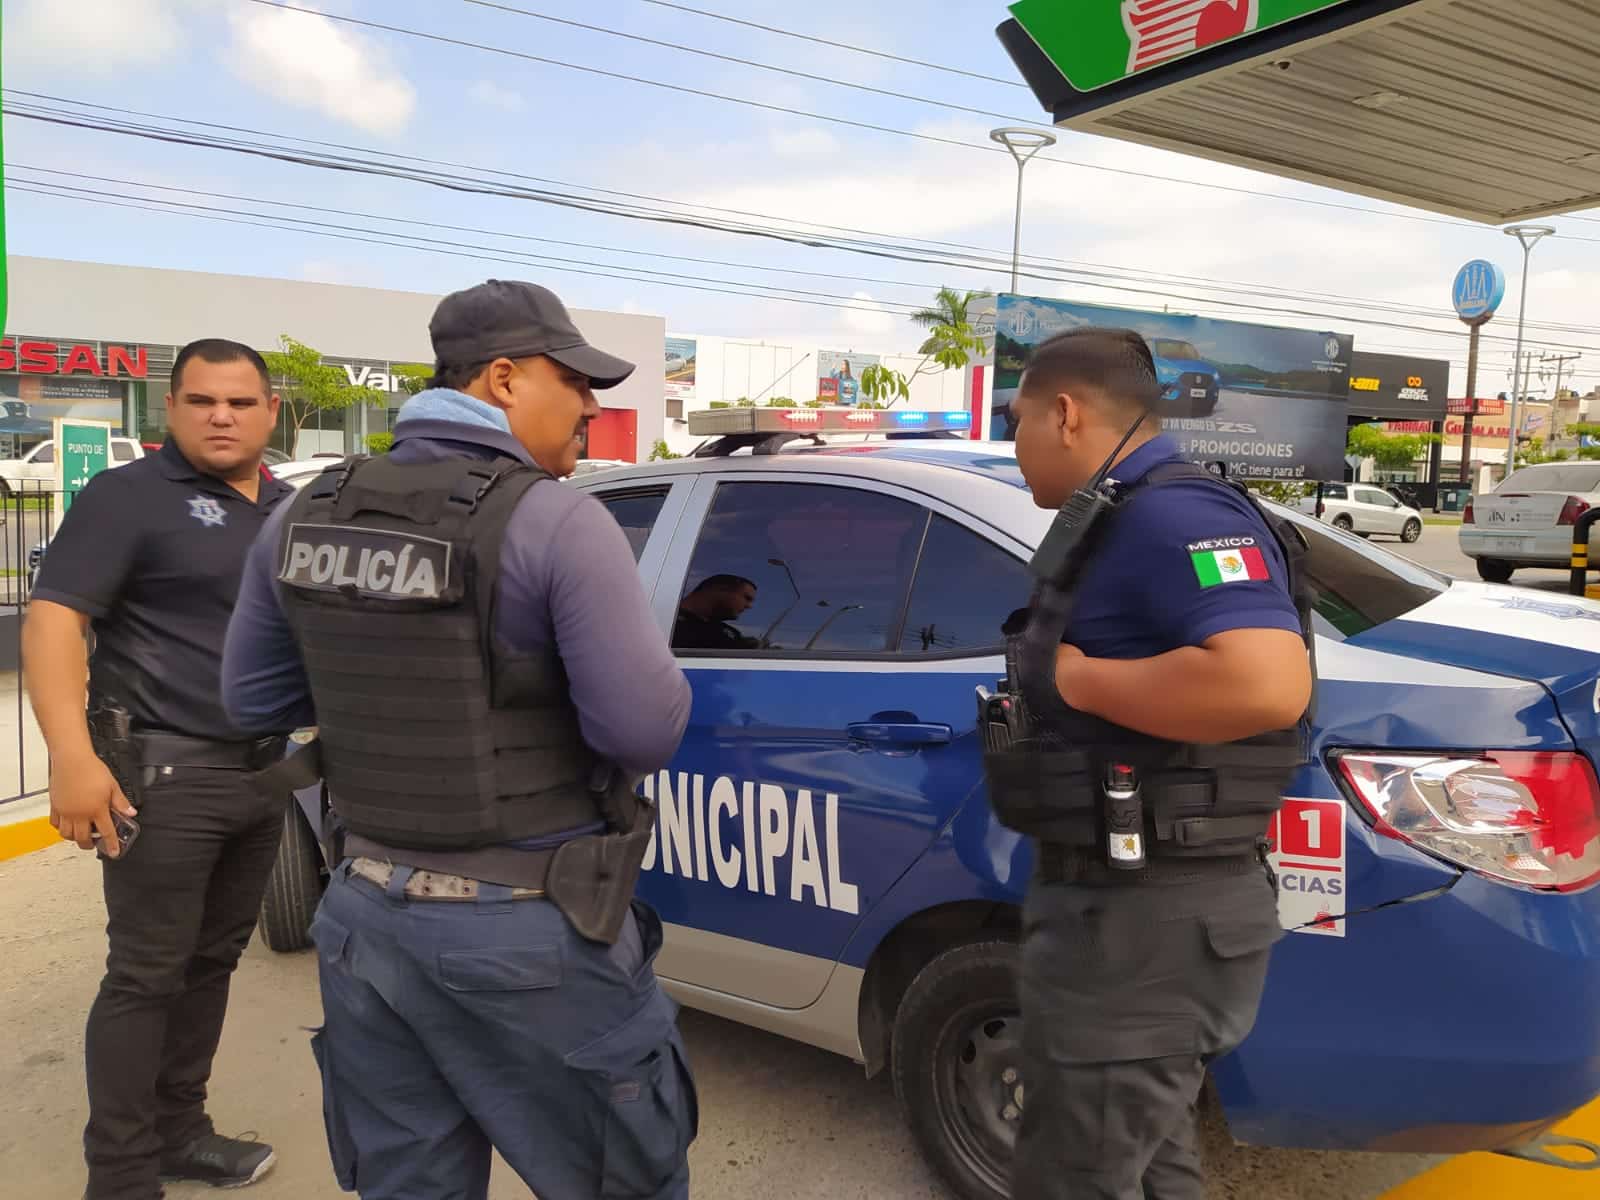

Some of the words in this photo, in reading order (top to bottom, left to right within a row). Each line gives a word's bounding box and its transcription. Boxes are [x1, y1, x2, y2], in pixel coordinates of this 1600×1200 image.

[67, 443, 93, 454] PUNTO
[93, 444, 104, 455] DE
[1190, 439, 1293, 458] PROMOCIONES
[1229, 462, 1247, 475] MG
[1249, 464, 1271, 476] tiene
[1273, 467, 1293, 479] para
[1188, 537, 1255, 551] MEXICO
[286, 543, 439, 597] POLICÍA
[1299, 809, 1321, 849] 1
